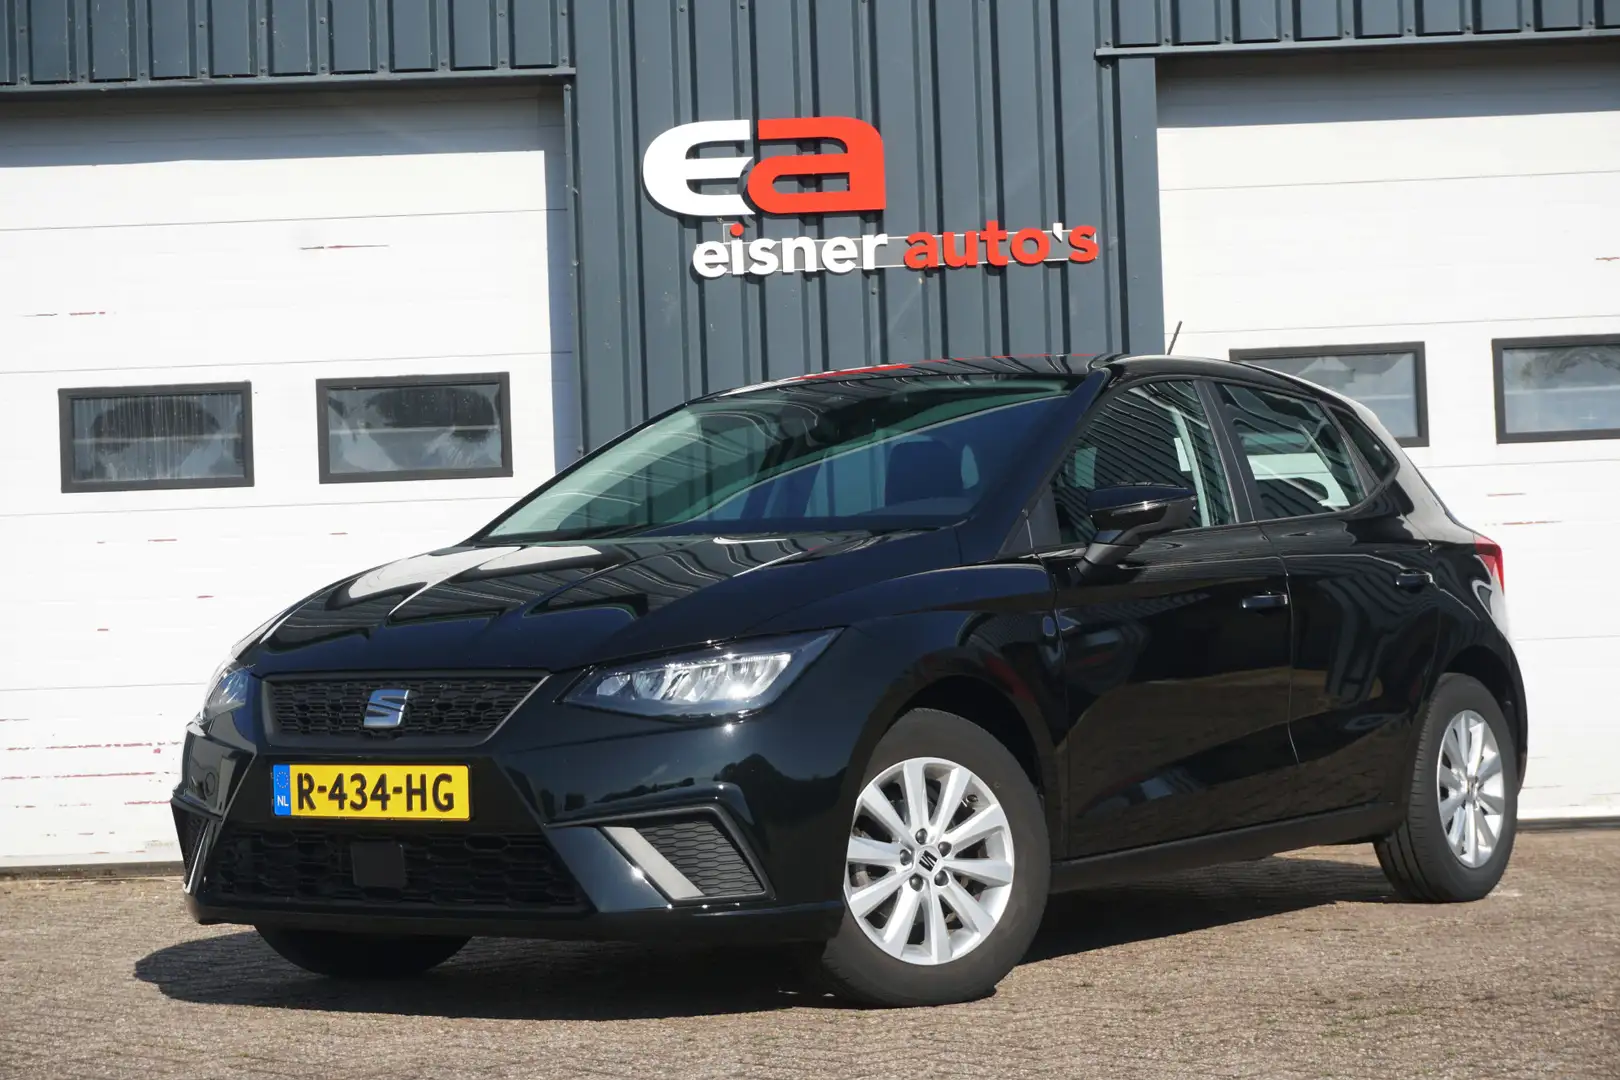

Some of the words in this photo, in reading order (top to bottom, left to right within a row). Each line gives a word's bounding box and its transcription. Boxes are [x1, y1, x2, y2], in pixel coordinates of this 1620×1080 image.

[642, 116, 887, 216] ea
[692, 222, 888, 278] eisner
[903, 219, 1100, 270] auto's
[276, 795, 290, 808] NL
[296, 772, 455, 813] R-434-HG
